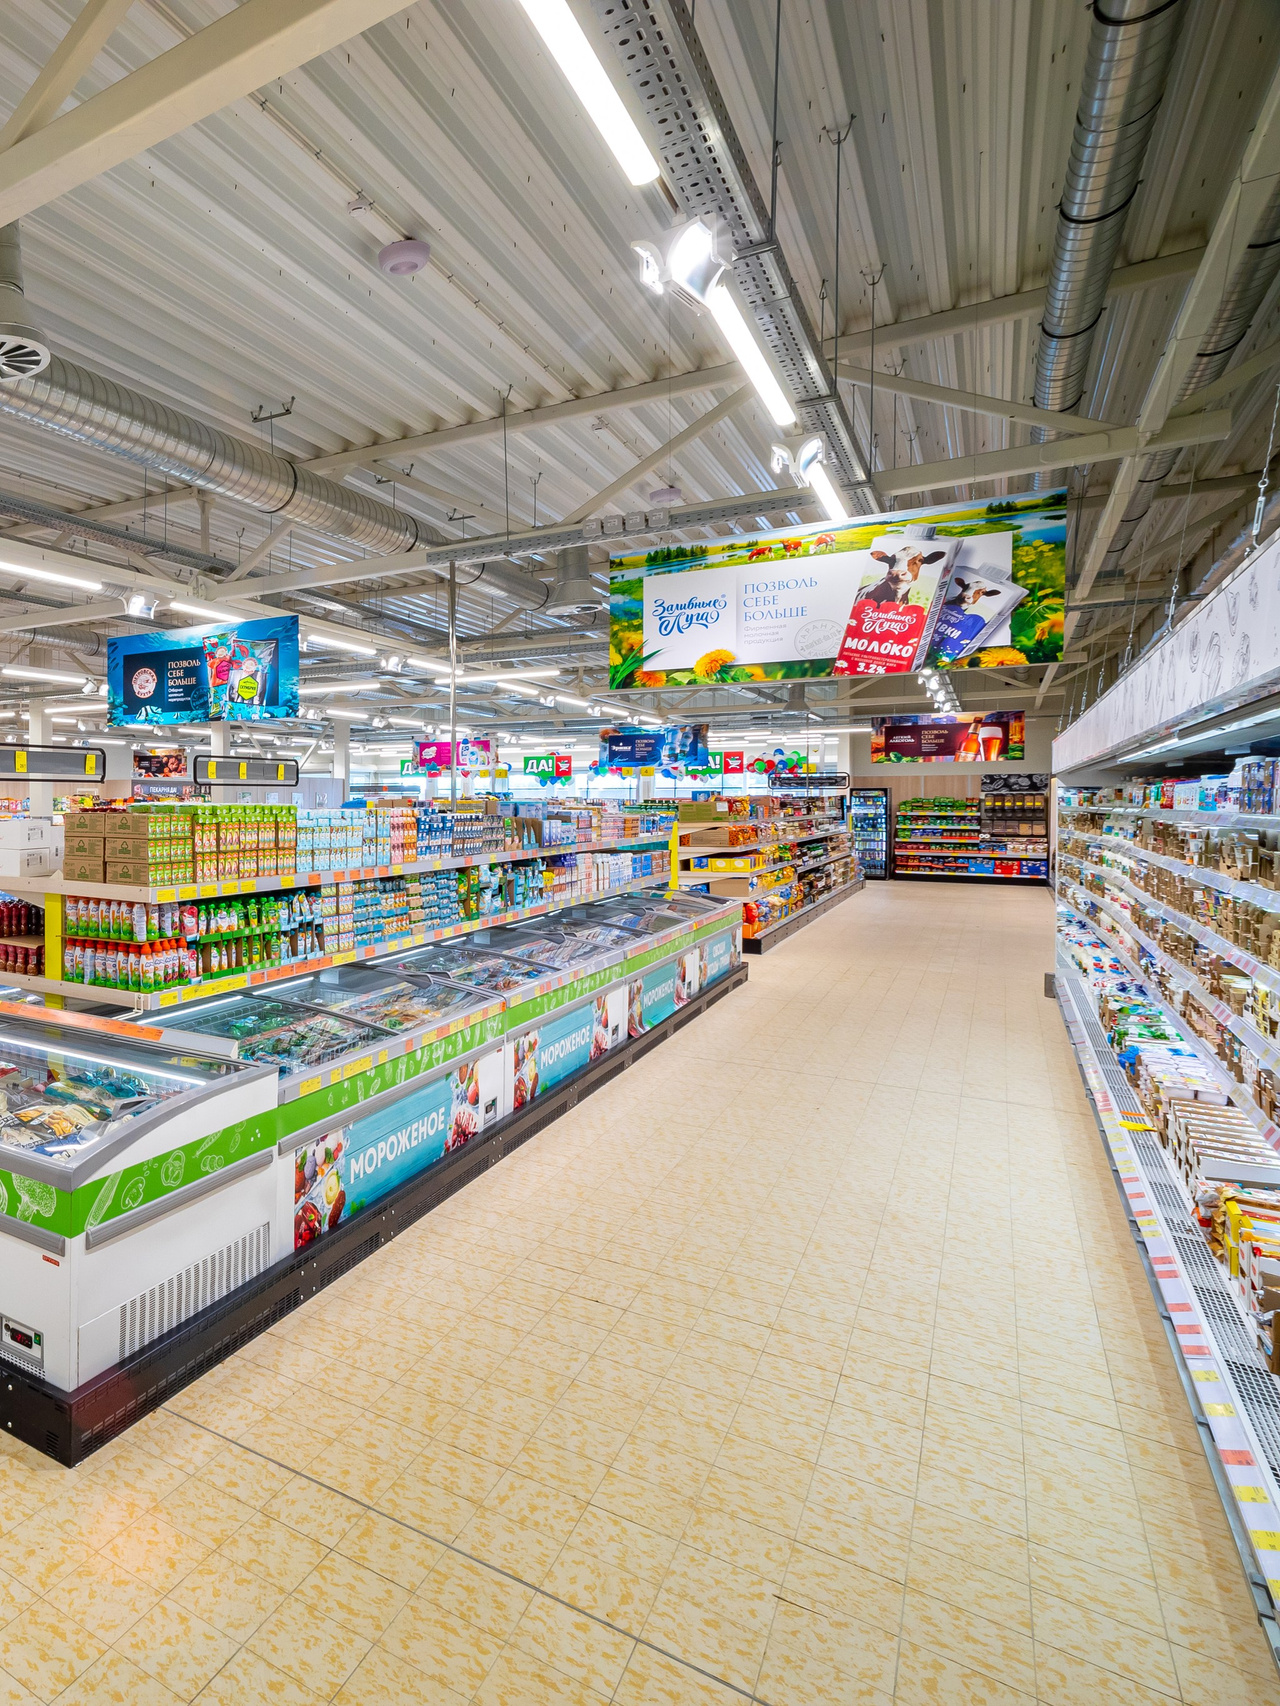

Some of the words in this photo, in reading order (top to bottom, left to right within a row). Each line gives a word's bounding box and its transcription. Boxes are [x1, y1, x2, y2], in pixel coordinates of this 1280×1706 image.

[744, 577, 818, 594] ПОЗВОЛЬ
[652, 596, 727, 617] Заливные
[743, 595, 779, 608] СЕБЕ
[744, 606, 808, 621] БОЛЬШЕ
[861, 606, 916, 625] Заливные
[658, 611, 720, 637] Луга
[744, 624, 787, 632] Фирменная
[861, 618, 909, 635] Луга
[744, 637, 783, 645] продукция
[844, 637, 914, 658] МОЛОКО
[168, 659, 201, 669] ПОЗВОЛЬ
[856, 662, 887, 674] 3.2%
[167, 669, 184, 677] СЕБЕ
[168, 677, 197, 686] БОЛЬШЕ
[525, 758, 553, 774] ДА!
[643, 978, 674, 1009] МОРОЖЕНОЕ
[540, 1025, 591, 1070] МОРОЖЕНОЕ
[350, 1107, 445, 1184] МОРОЖЕНОЕ
